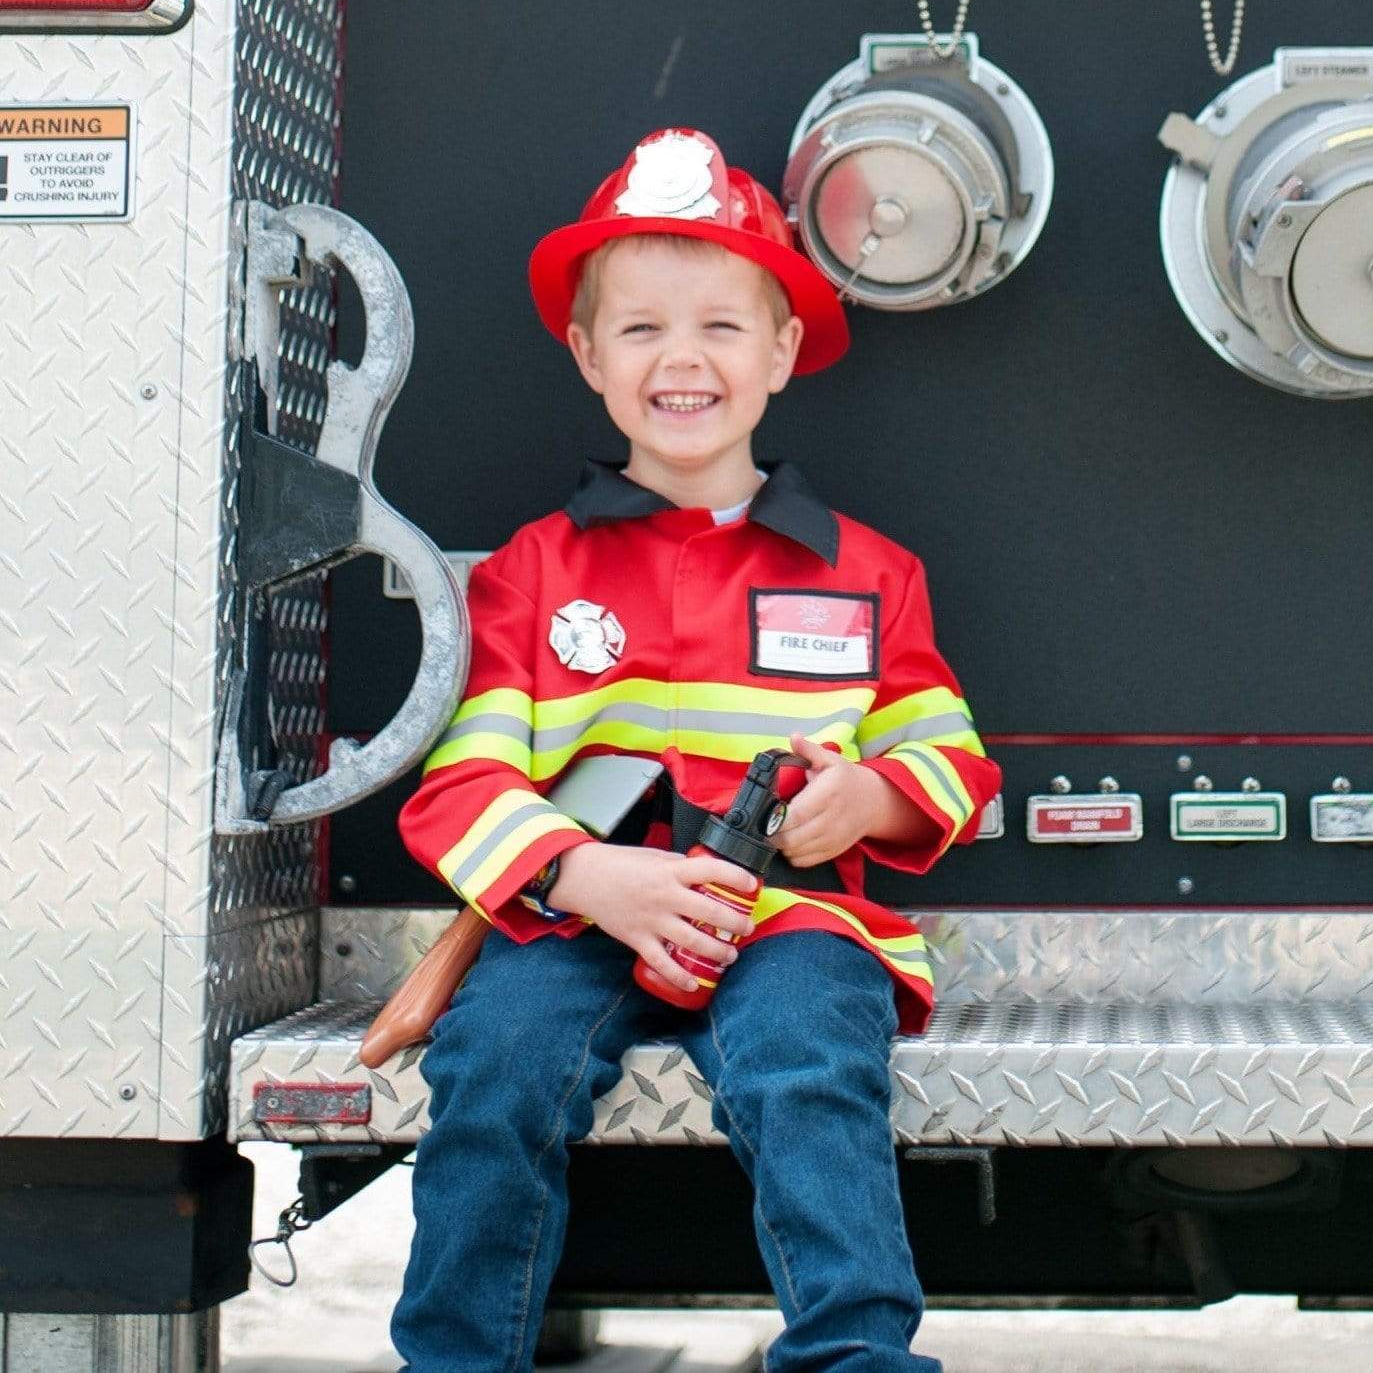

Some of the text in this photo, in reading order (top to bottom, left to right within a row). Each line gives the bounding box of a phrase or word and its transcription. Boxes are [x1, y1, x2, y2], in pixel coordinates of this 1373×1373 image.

[0, 118, 103, 134] WARNING
[24, 152, 113, 162] STAY CLEAR OF
[30, 166, 105, 176] OUTRIGGERS
[41, 178, 94, 188] TO AVOID
[14, 191, 119, 202] CRUSHING INJURY
[780, 635, 849, 653] FIRE CHIEF
[1187, 820, 1267, 828] LARGE DISCHARGE
